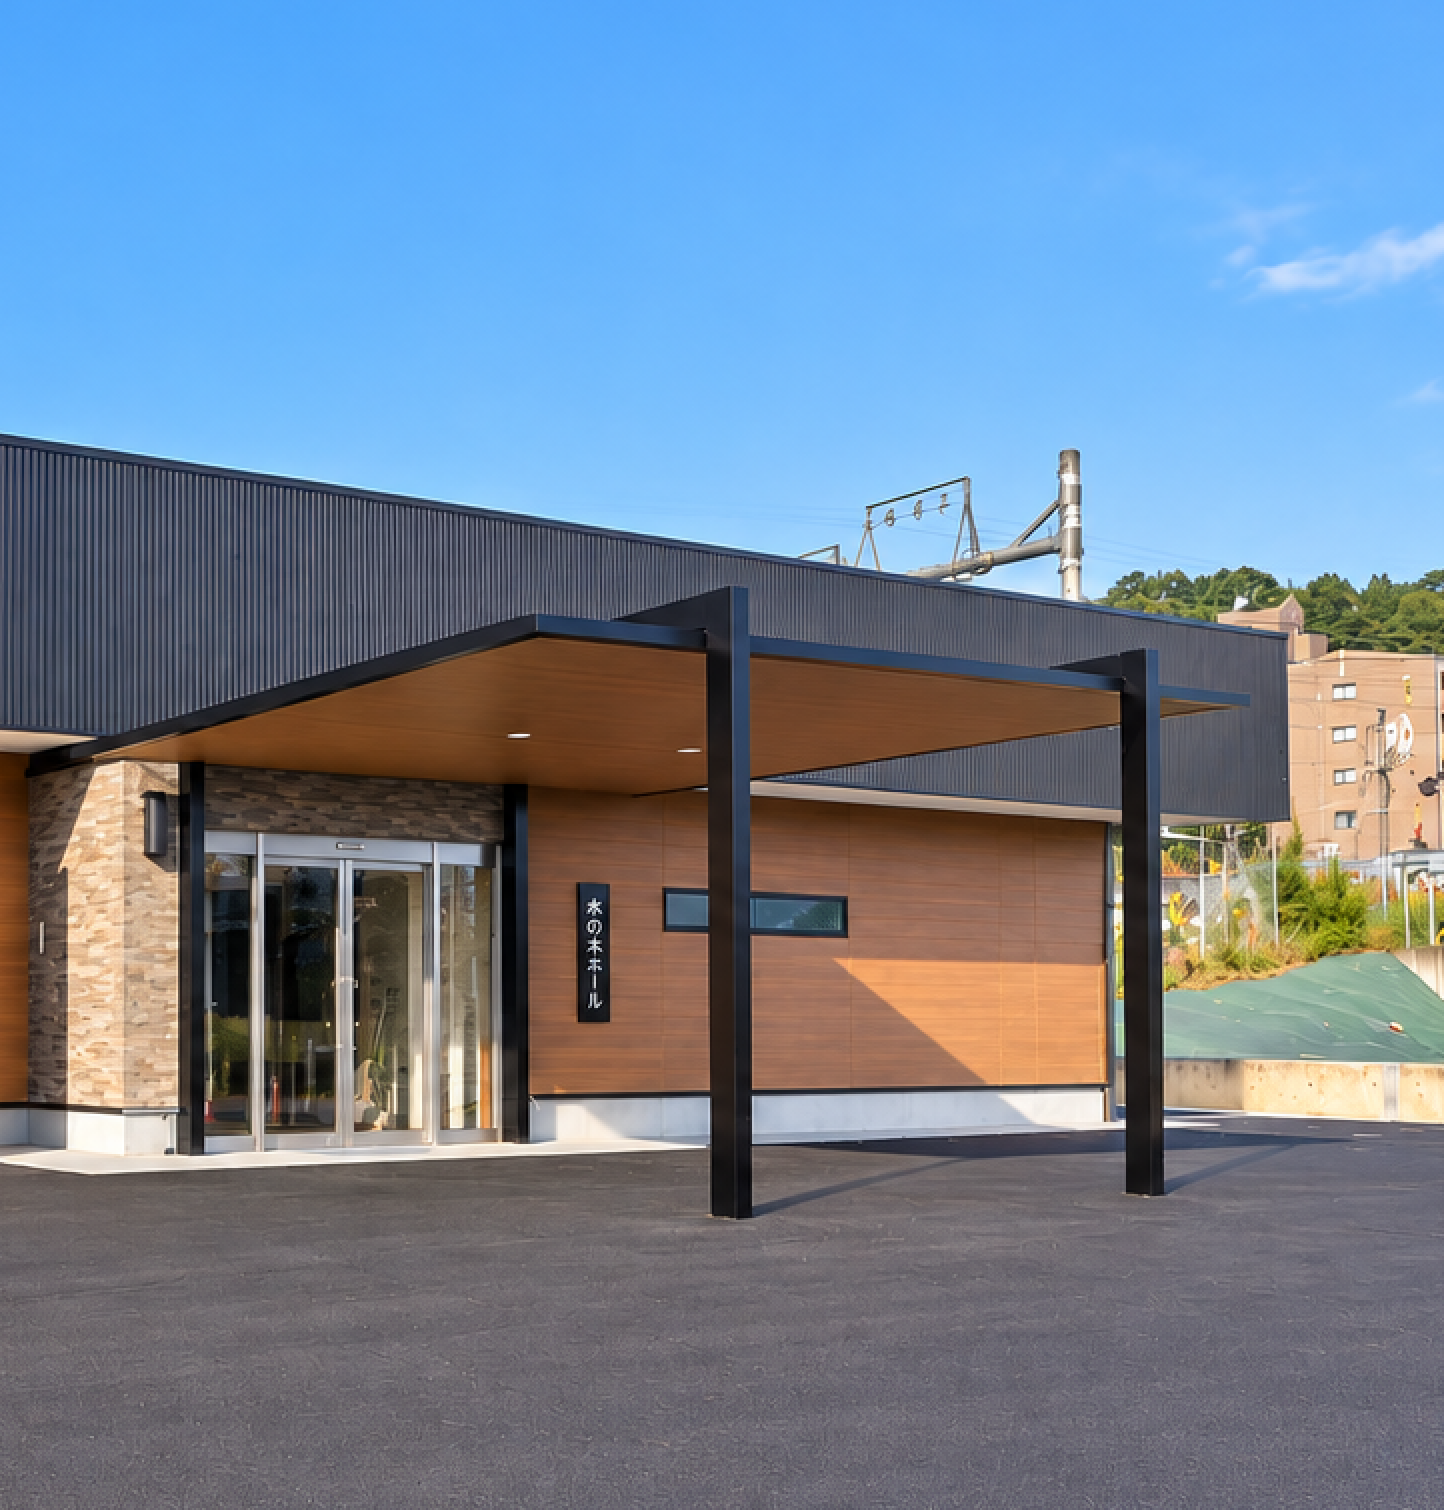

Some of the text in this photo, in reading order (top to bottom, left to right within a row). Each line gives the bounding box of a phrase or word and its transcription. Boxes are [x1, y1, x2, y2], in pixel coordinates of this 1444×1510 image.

[587, 897, 603, 1009] 水の木ホール
